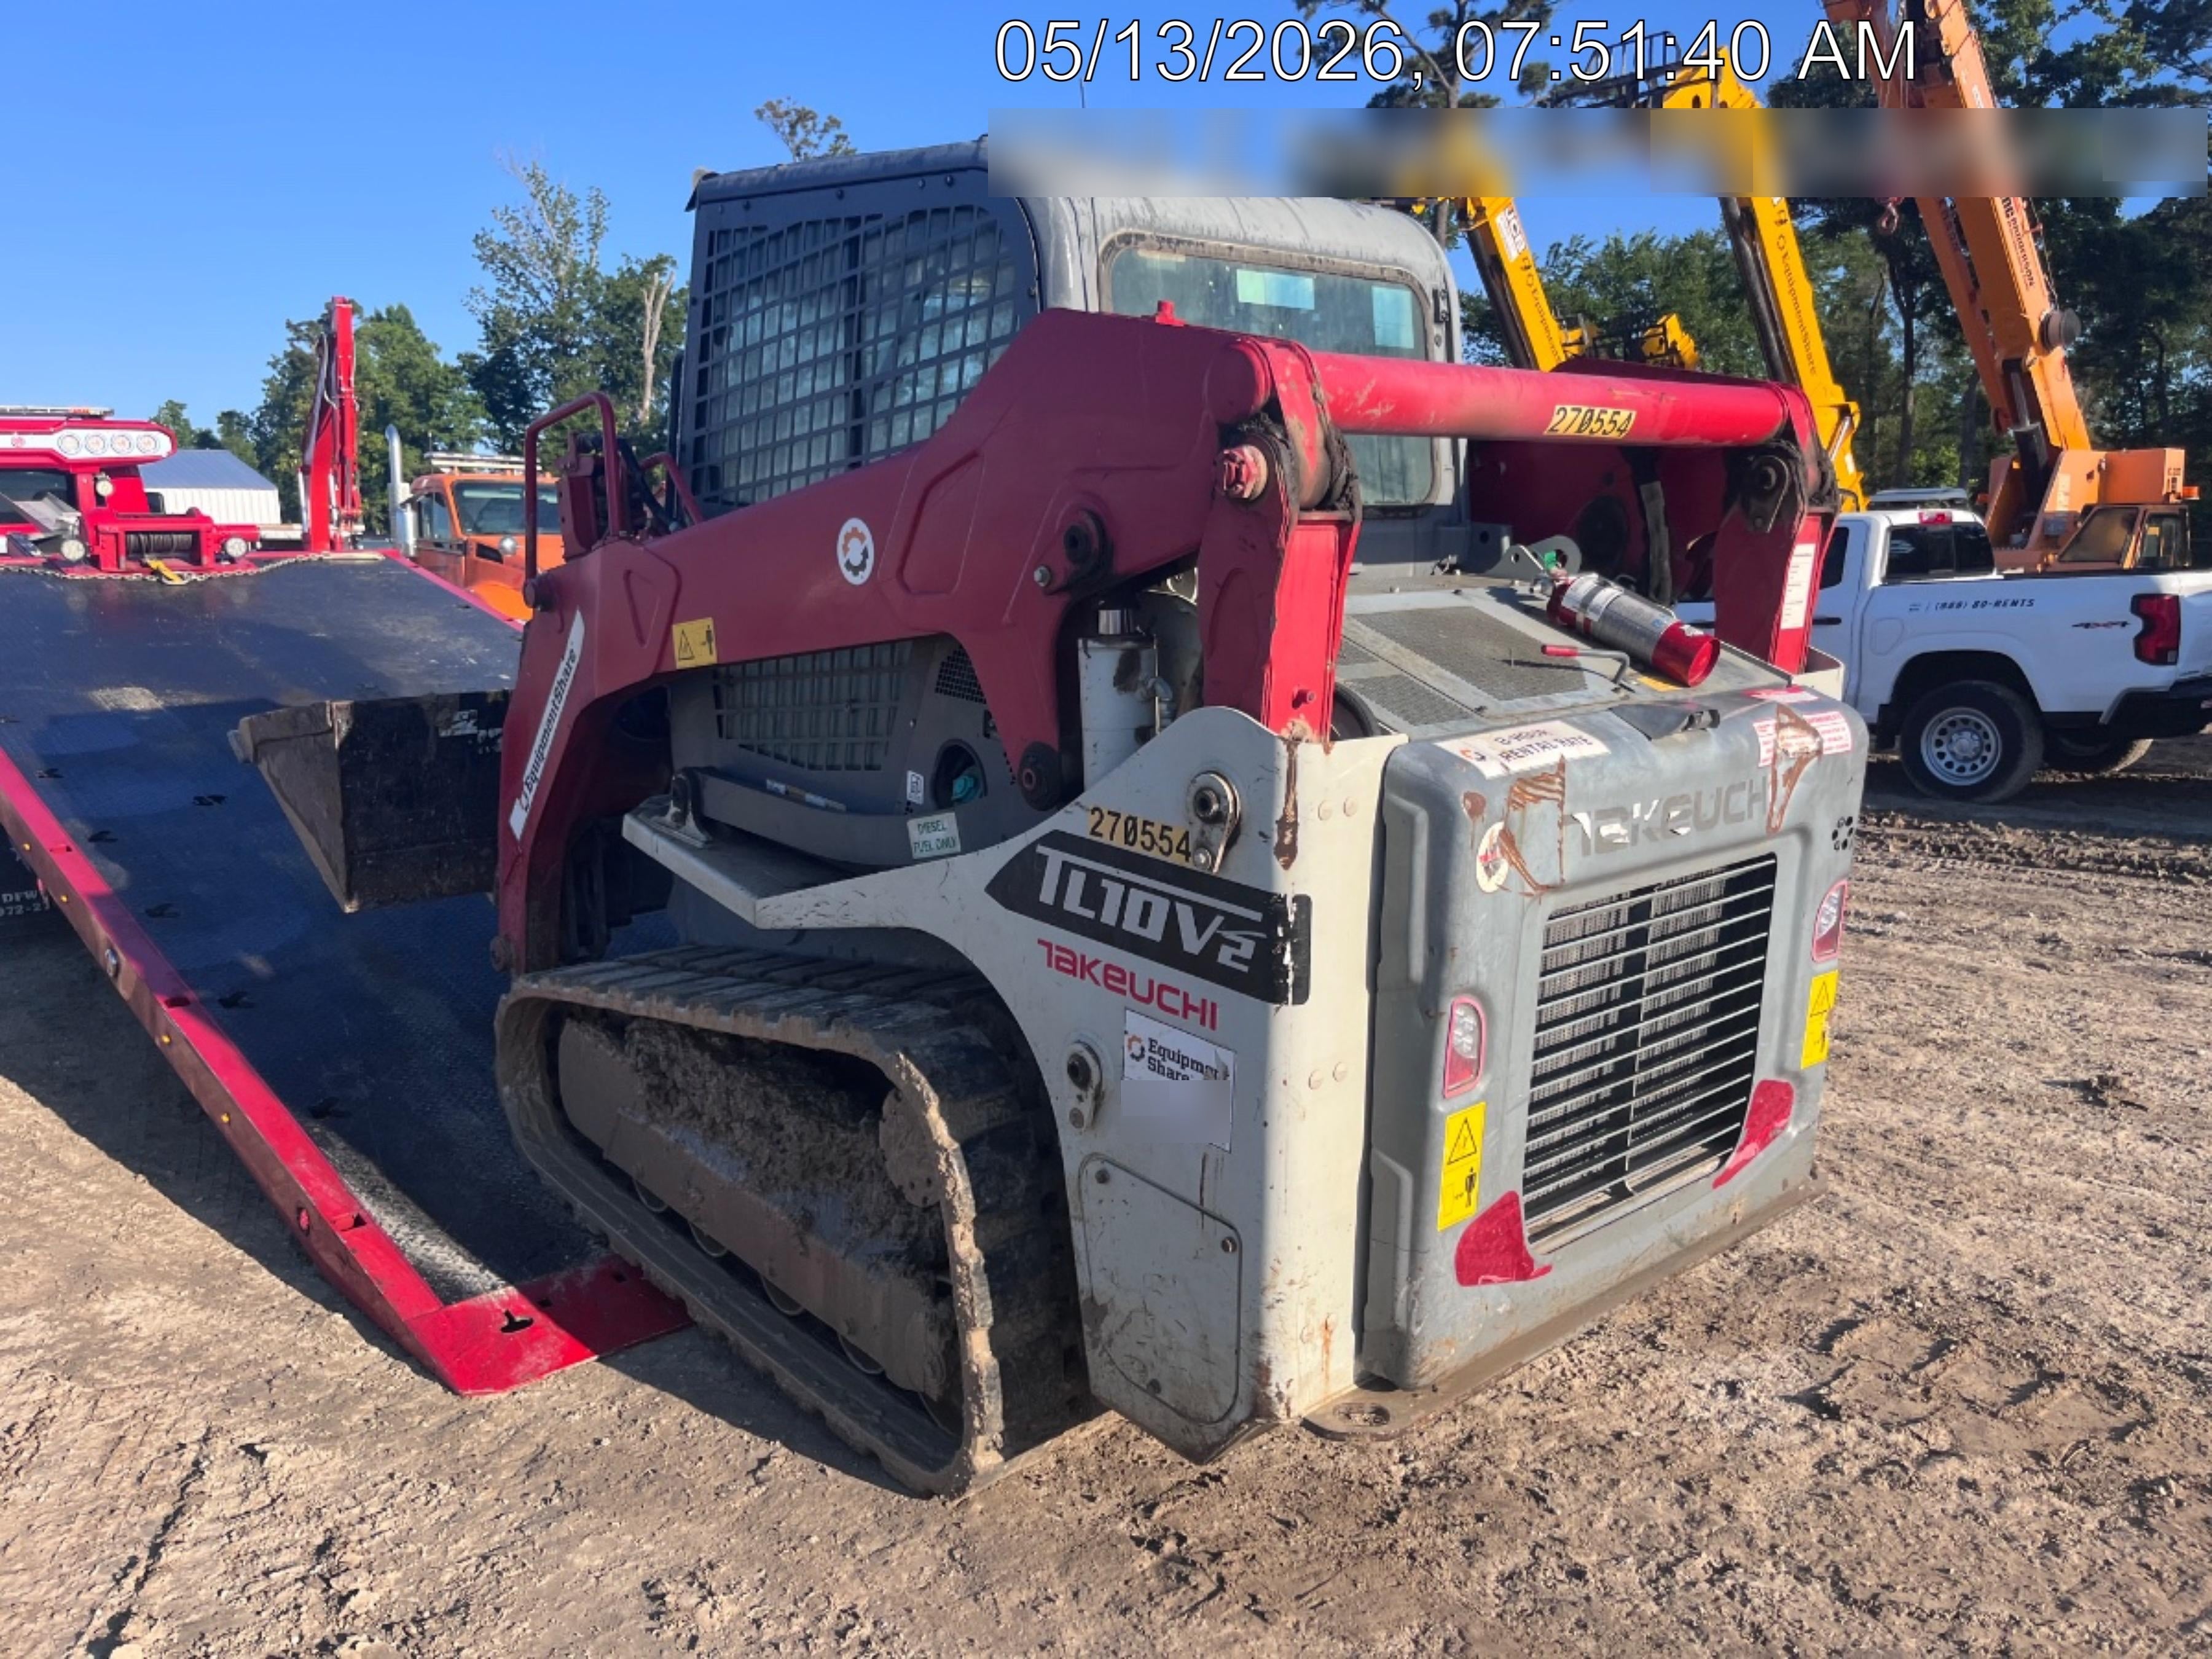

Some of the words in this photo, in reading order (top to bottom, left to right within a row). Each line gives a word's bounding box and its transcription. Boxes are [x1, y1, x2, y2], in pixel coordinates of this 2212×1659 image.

[1548, 407, 1634, 436] 270554
[918, 820, 947, 836] DIESEL
[1089, 807, 1191, 862] 270554
